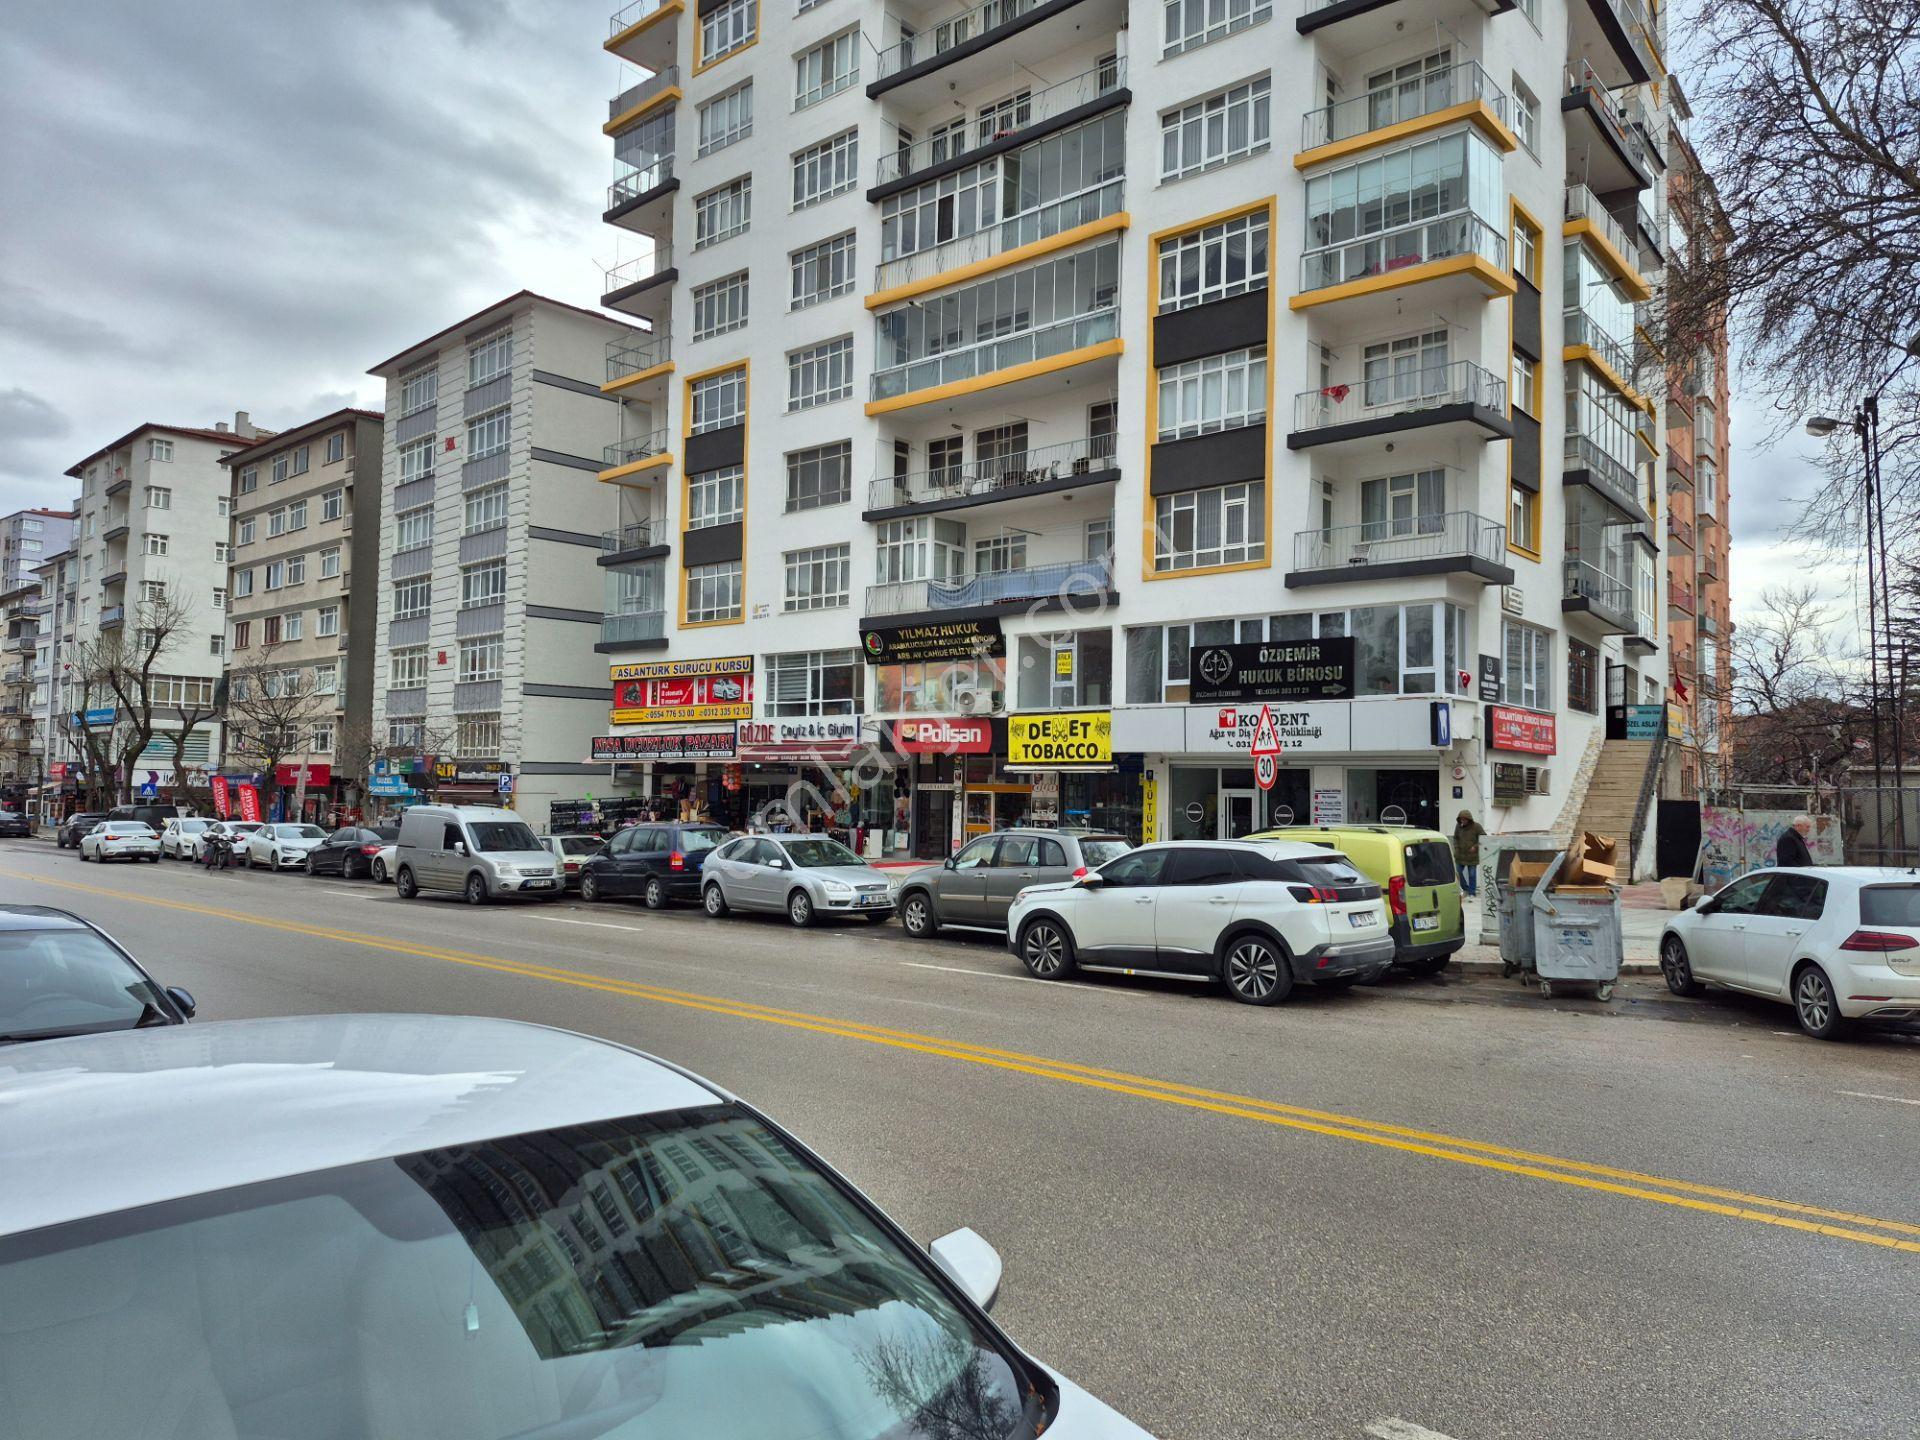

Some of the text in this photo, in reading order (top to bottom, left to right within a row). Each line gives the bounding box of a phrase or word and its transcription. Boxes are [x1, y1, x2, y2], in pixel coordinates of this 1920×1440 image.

[898, 622, 980, 639] YILMAZ HUKUK
[1259, 643, 1320, 663] ÖZDEMİR
[715, 660, 750, 673] KURSU
[1239, 663, 1343, 685] HUKUK BÜROSU
[666, 710, 677, 718] 776
[686, 708, 695, 717] 00
[704, 708, 718, 717] 0312
[733, 706, 740, 714] 12
[1238, 713, 1310, 727] KODENT
[739, 722, 775, 743] GÖZDE
[781, 724, 806, 739] Çeyiz
[808, 724, 815, 736] &
[827, 722, 855, 738] Giyim
[919, 723, 982, 743] Polisan
[1028, 717, 1091, 742] DEMET
[1209, 728, 1226, 740] Ağız
[1226, 729, 1236, 737] ve
[1238, 728, 1251, 739] Diş
[1281, 726, 1322, 738] Polikliniği
[624, 736, 683, 752] UCUZLUK
[685, 734, 735, 751] PAZARI
[1022, 743, 1099, 759] TOBACCO
[1236, 740, 1253, 748] 031
[1291, 739, 1303, 747] 12
[1259, 757, 1272, 778] 30
[501, 775, 509, 786] P
